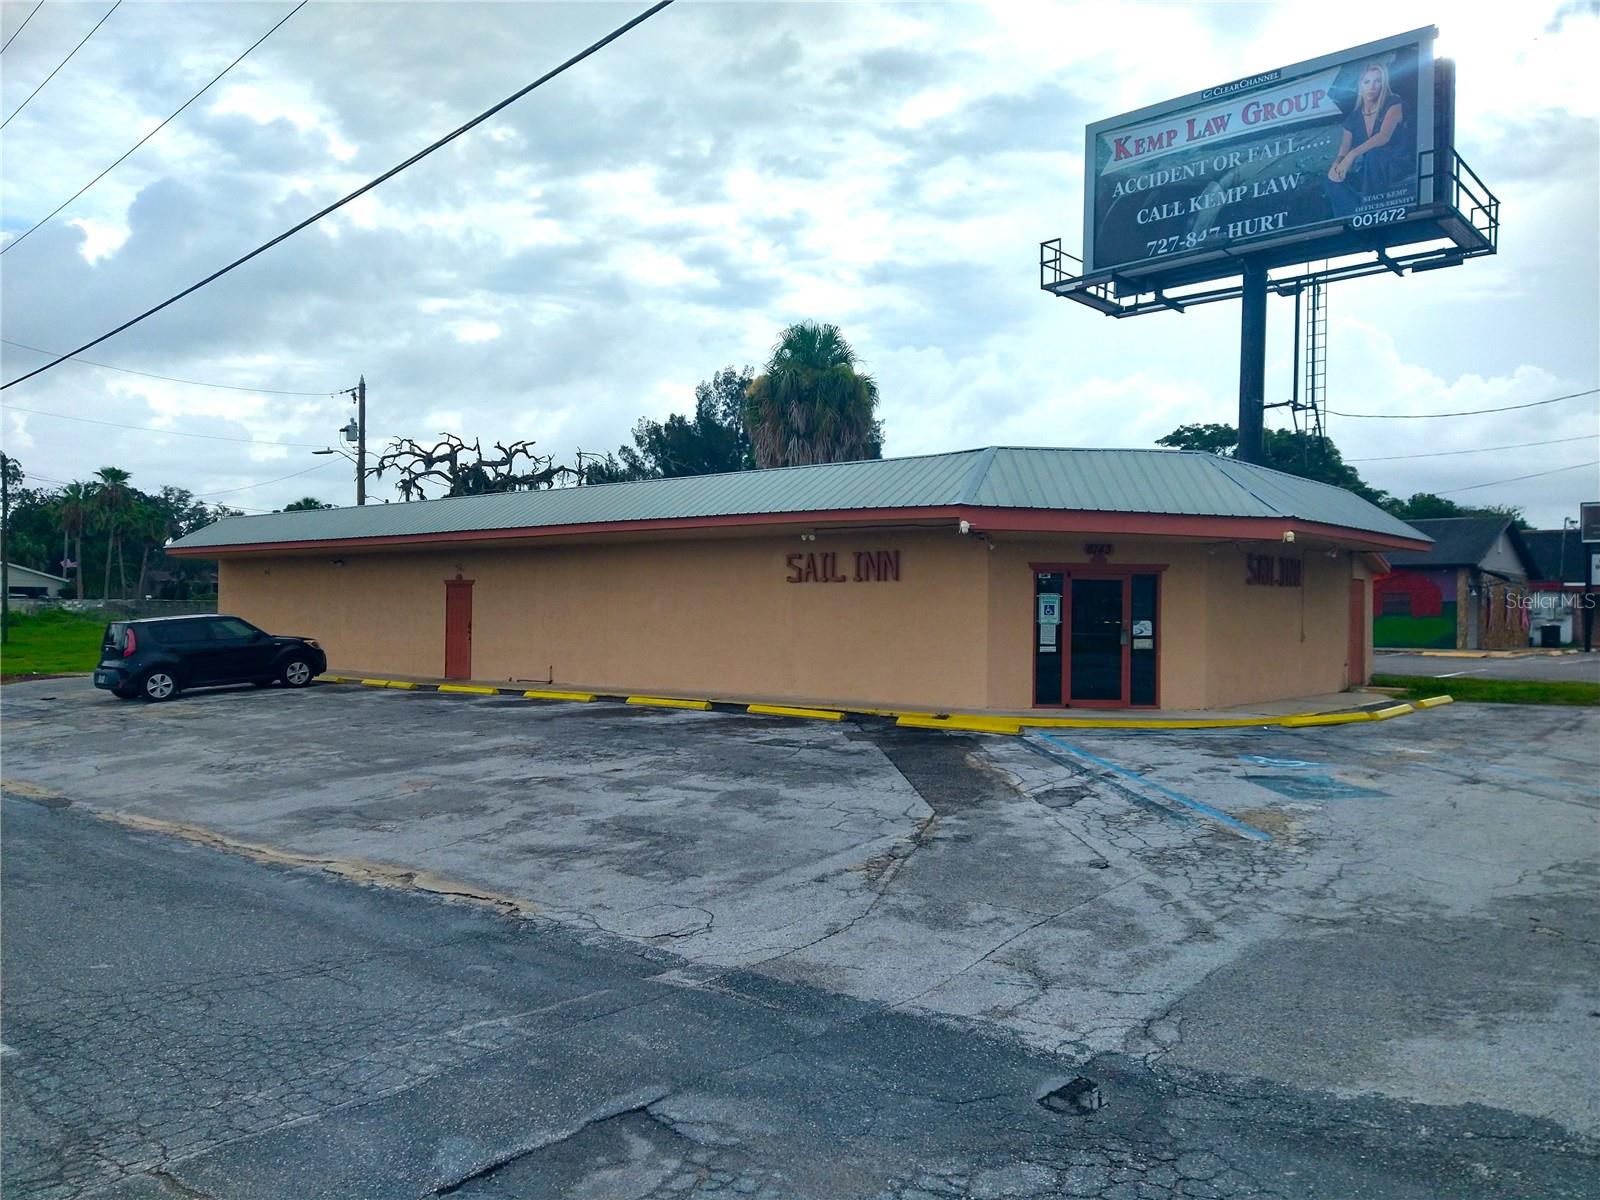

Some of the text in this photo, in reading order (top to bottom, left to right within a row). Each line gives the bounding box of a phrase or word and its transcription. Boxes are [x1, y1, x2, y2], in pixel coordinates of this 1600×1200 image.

[1113, 89, 1326, 162] KEMP LAW GROUP
[1111, 159, 1209, 198] ACCIDENT
[1212, 151, 1242, 172] OR
[1136, 172, 1302, 225] CALL KEMP LAW
[1352, 207, 1406, 228] 001472
[786, 550, 900, 583] SAIL INN
